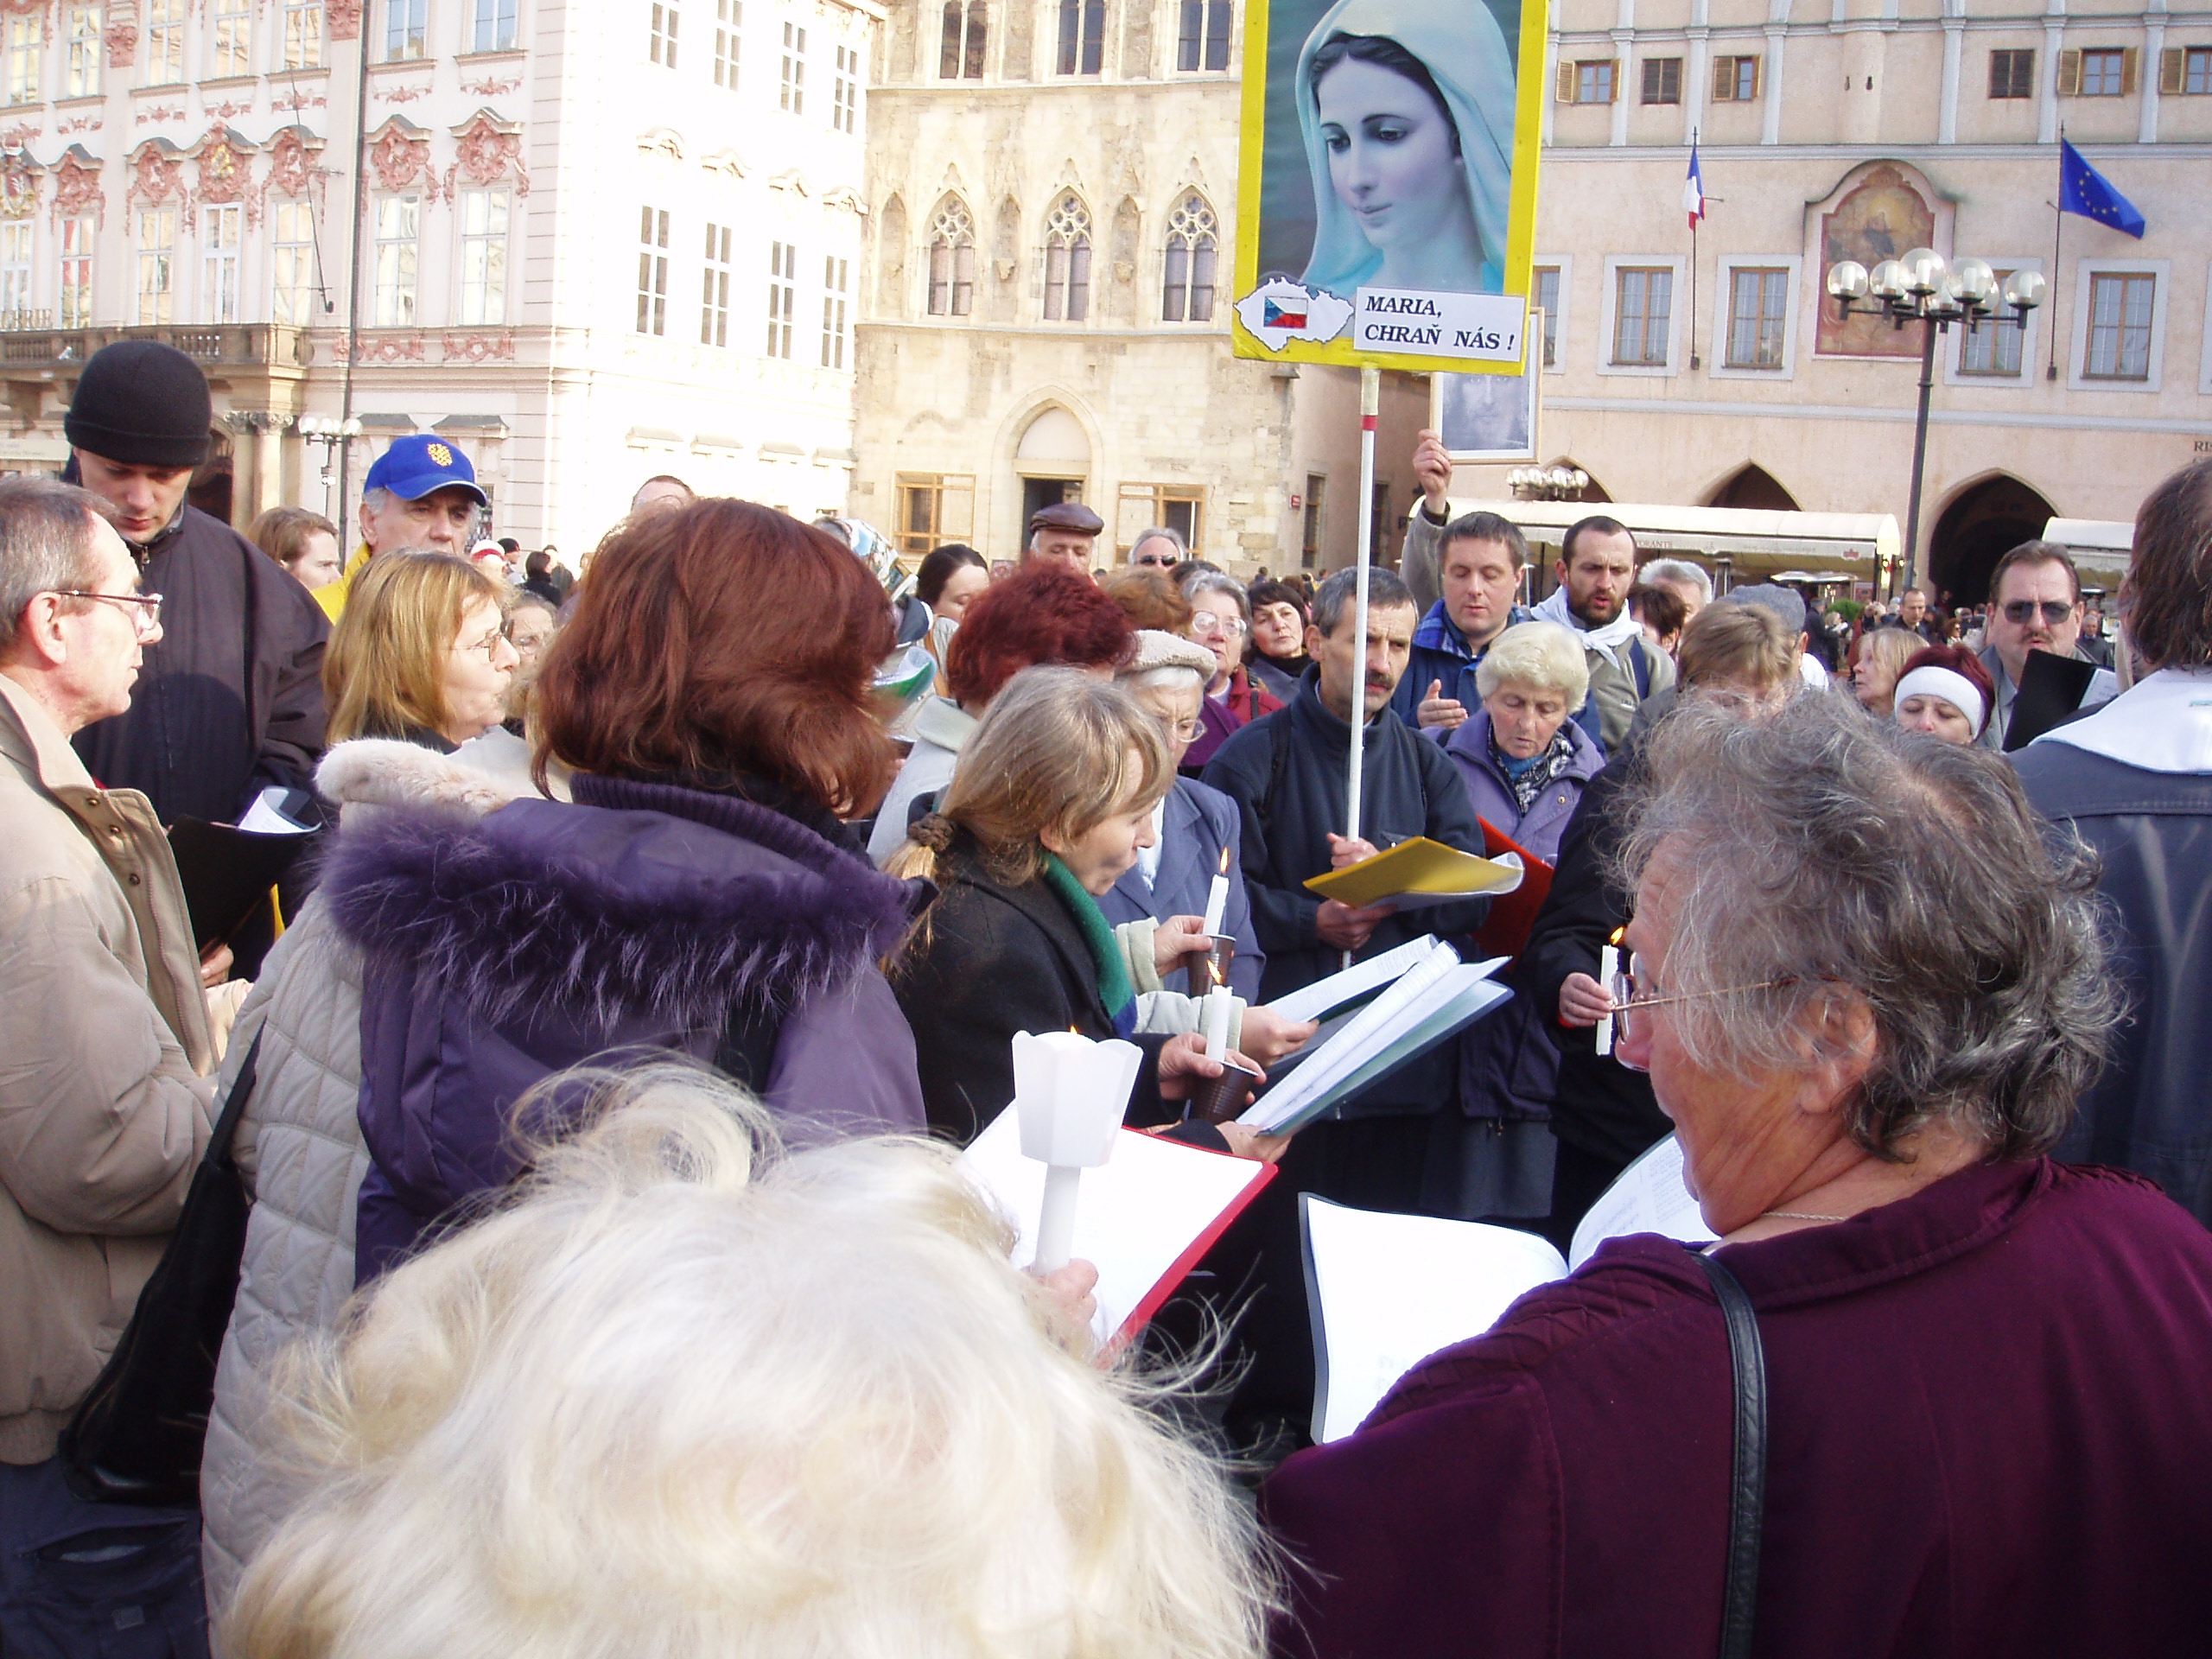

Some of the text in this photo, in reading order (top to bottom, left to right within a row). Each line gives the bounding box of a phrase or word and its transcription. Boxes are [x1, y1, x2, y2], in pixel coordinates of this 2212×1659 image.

[1365, 296, 1442, 317] MARIA,
[1364, 323, 1442, 346] CHRAŇ
[1453, 327, 1501, 350] NÁS
